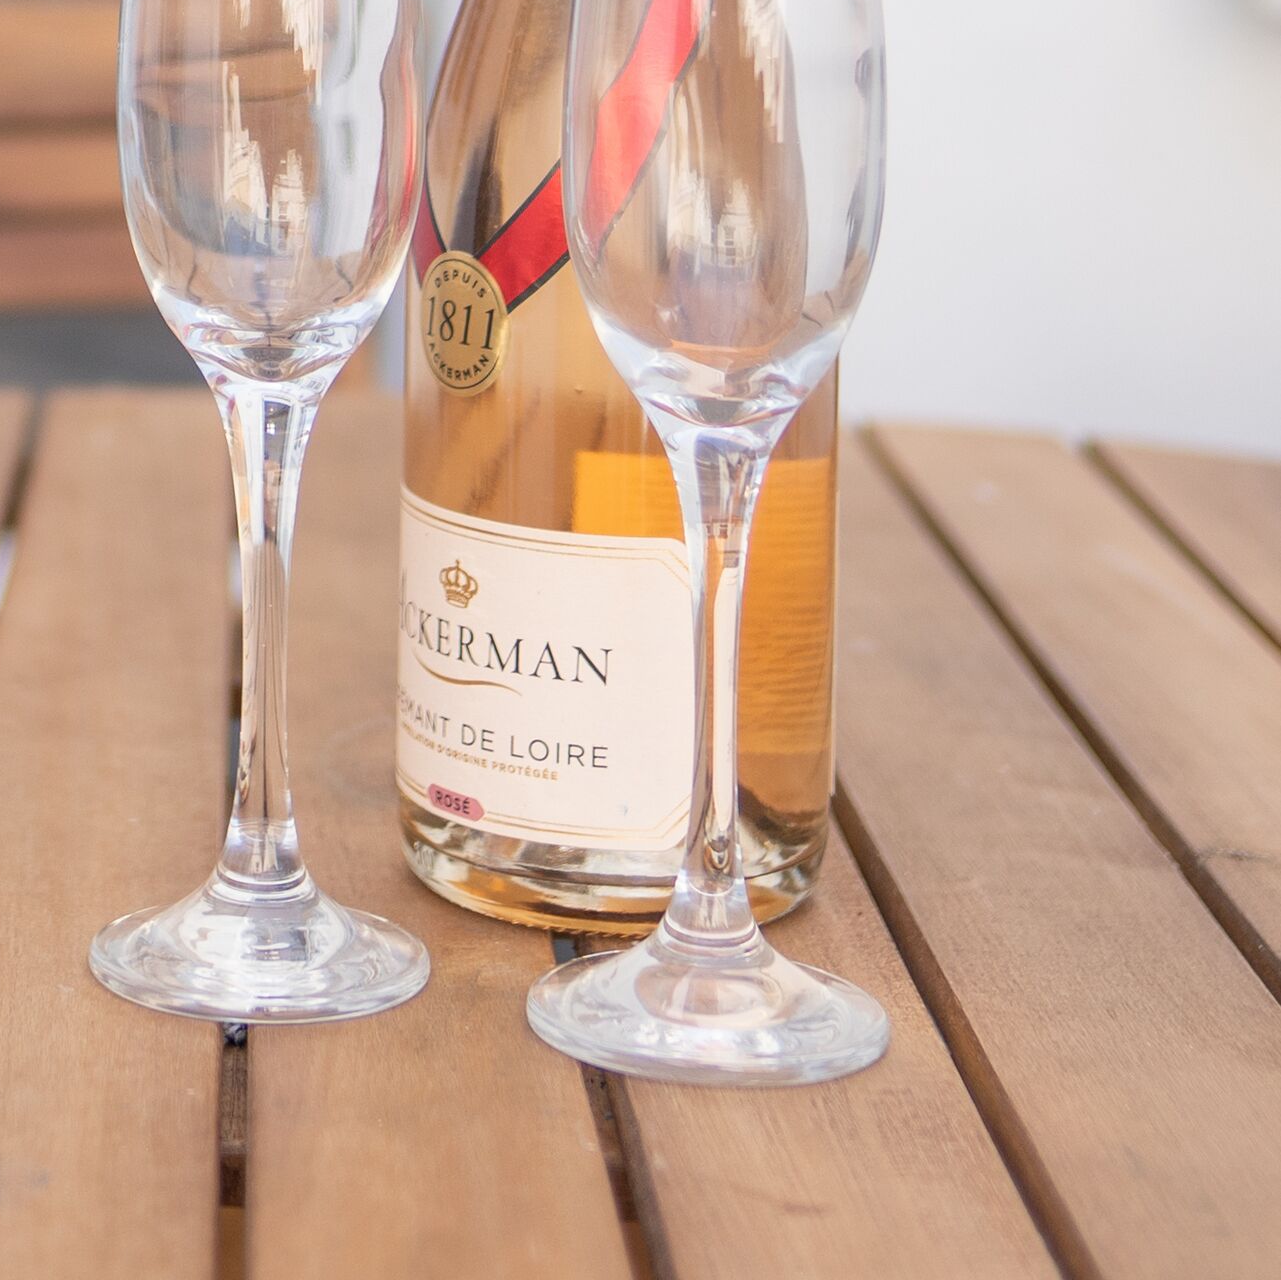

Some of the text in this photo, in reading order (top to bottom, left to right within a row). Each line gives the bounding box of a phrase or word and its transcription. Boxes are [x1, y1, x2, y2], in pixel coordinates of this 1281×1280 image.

[434, 269, 487, 298] DEPUIS
[426, 296, 495, 350] 1811
[428, 342, 490, 381] ACKERMAN
[460, 723, 495, 753] DE
[510, 735, 609, 769] LOIRE
[491, 760, 559, 782] PROTÉGÉE
[434, 790, 471, 816] ROSÉ
